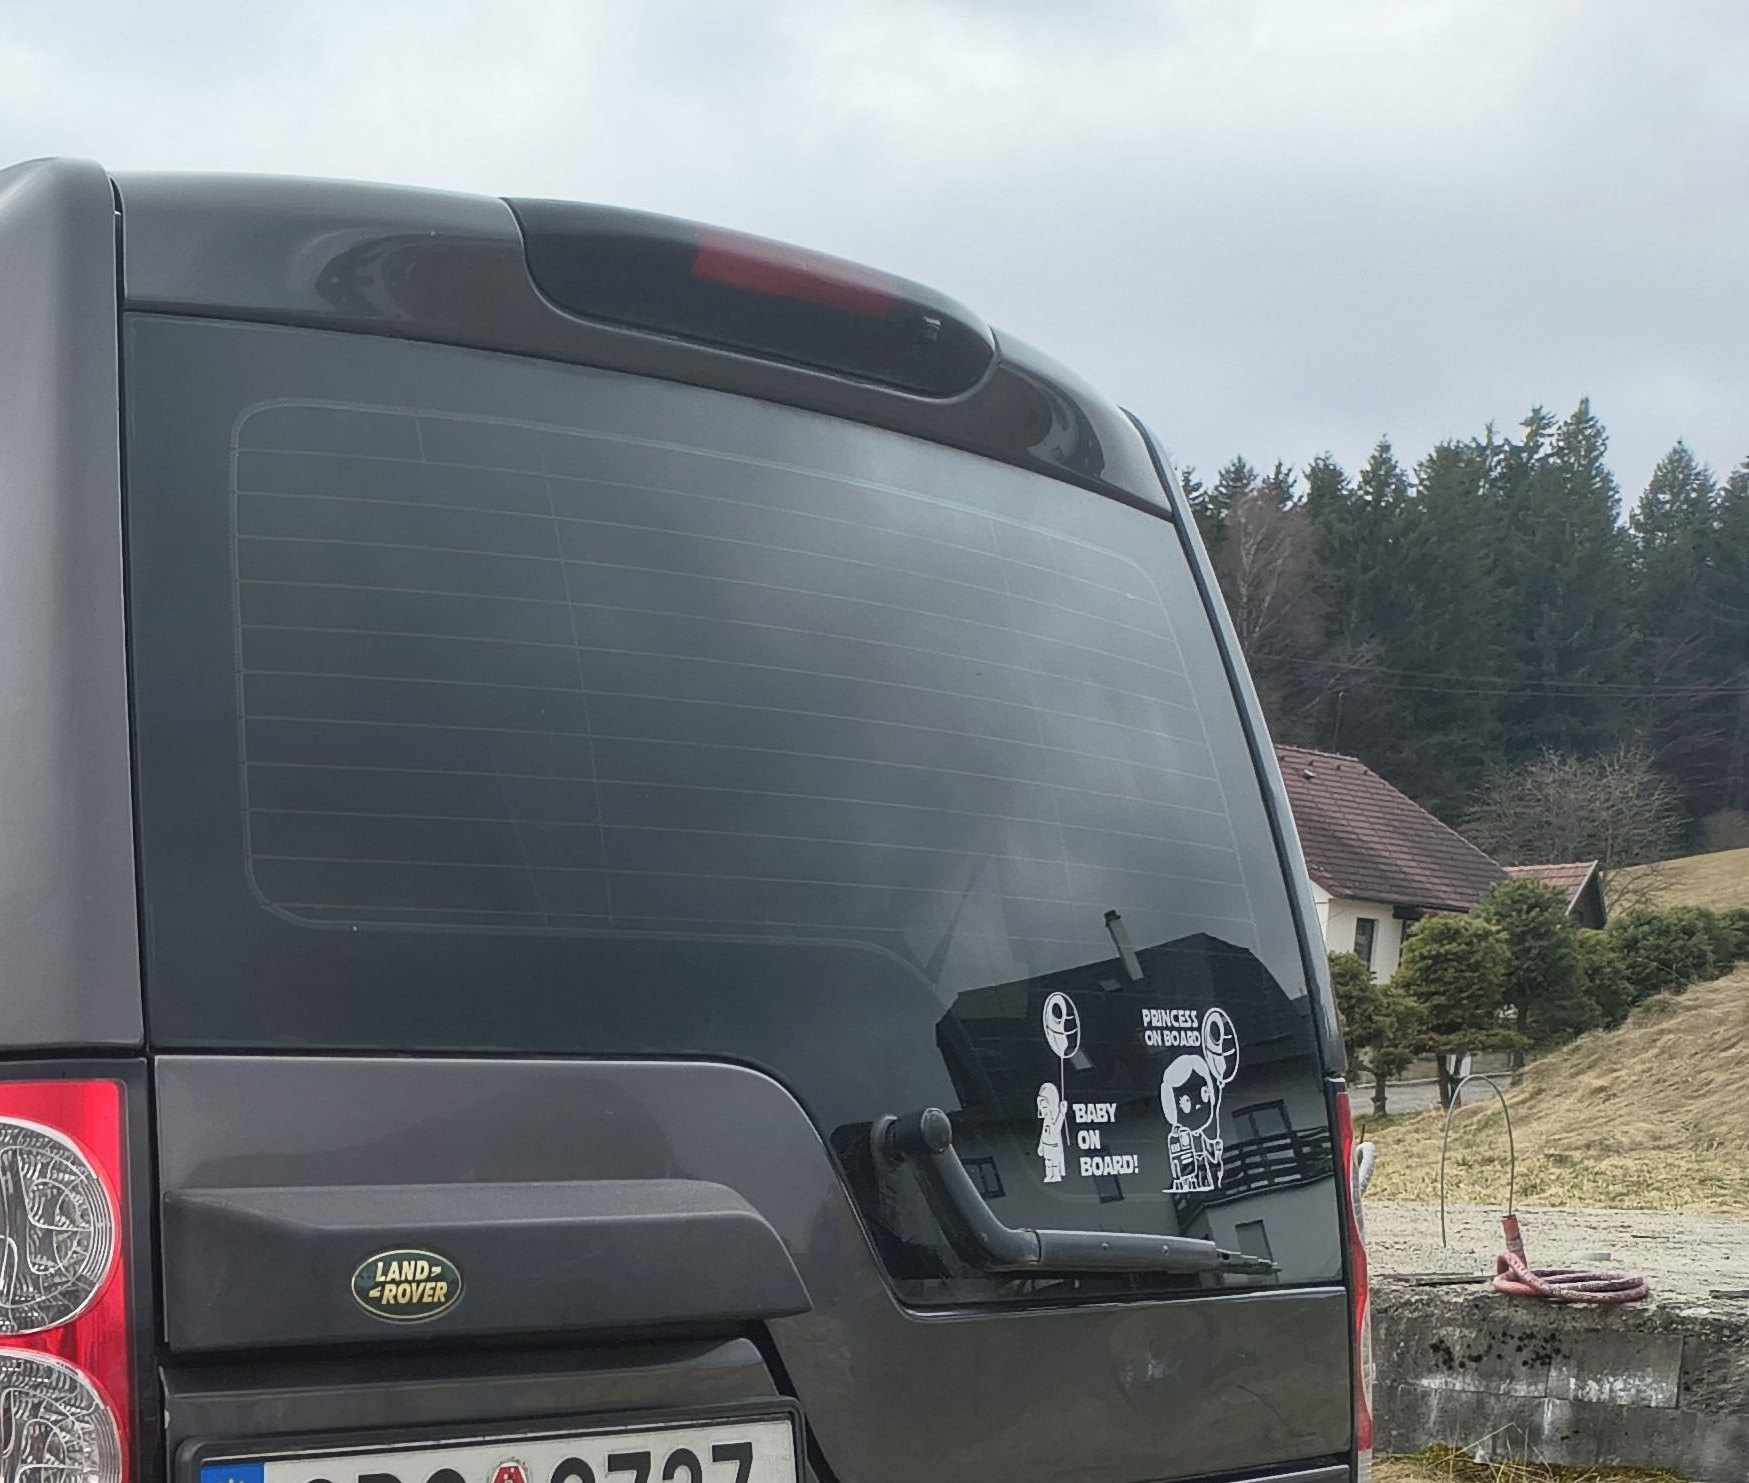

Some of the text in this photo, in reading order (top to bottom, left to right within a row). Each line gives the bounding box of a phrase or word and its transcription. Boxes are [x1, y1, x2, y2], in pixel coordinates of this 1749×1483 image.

[1142, 1008, 1199, 1028] PRINCESS
[1144, 1030, 1201, 1047] ON BOARD
[1072, 1103, 1117, 1123] BABY
[1077, 1129, 1101, 1150] ON
[1080, 1154, 1139, 1176] BOARD!
[381, 1281, 448, 1304] ROVER
